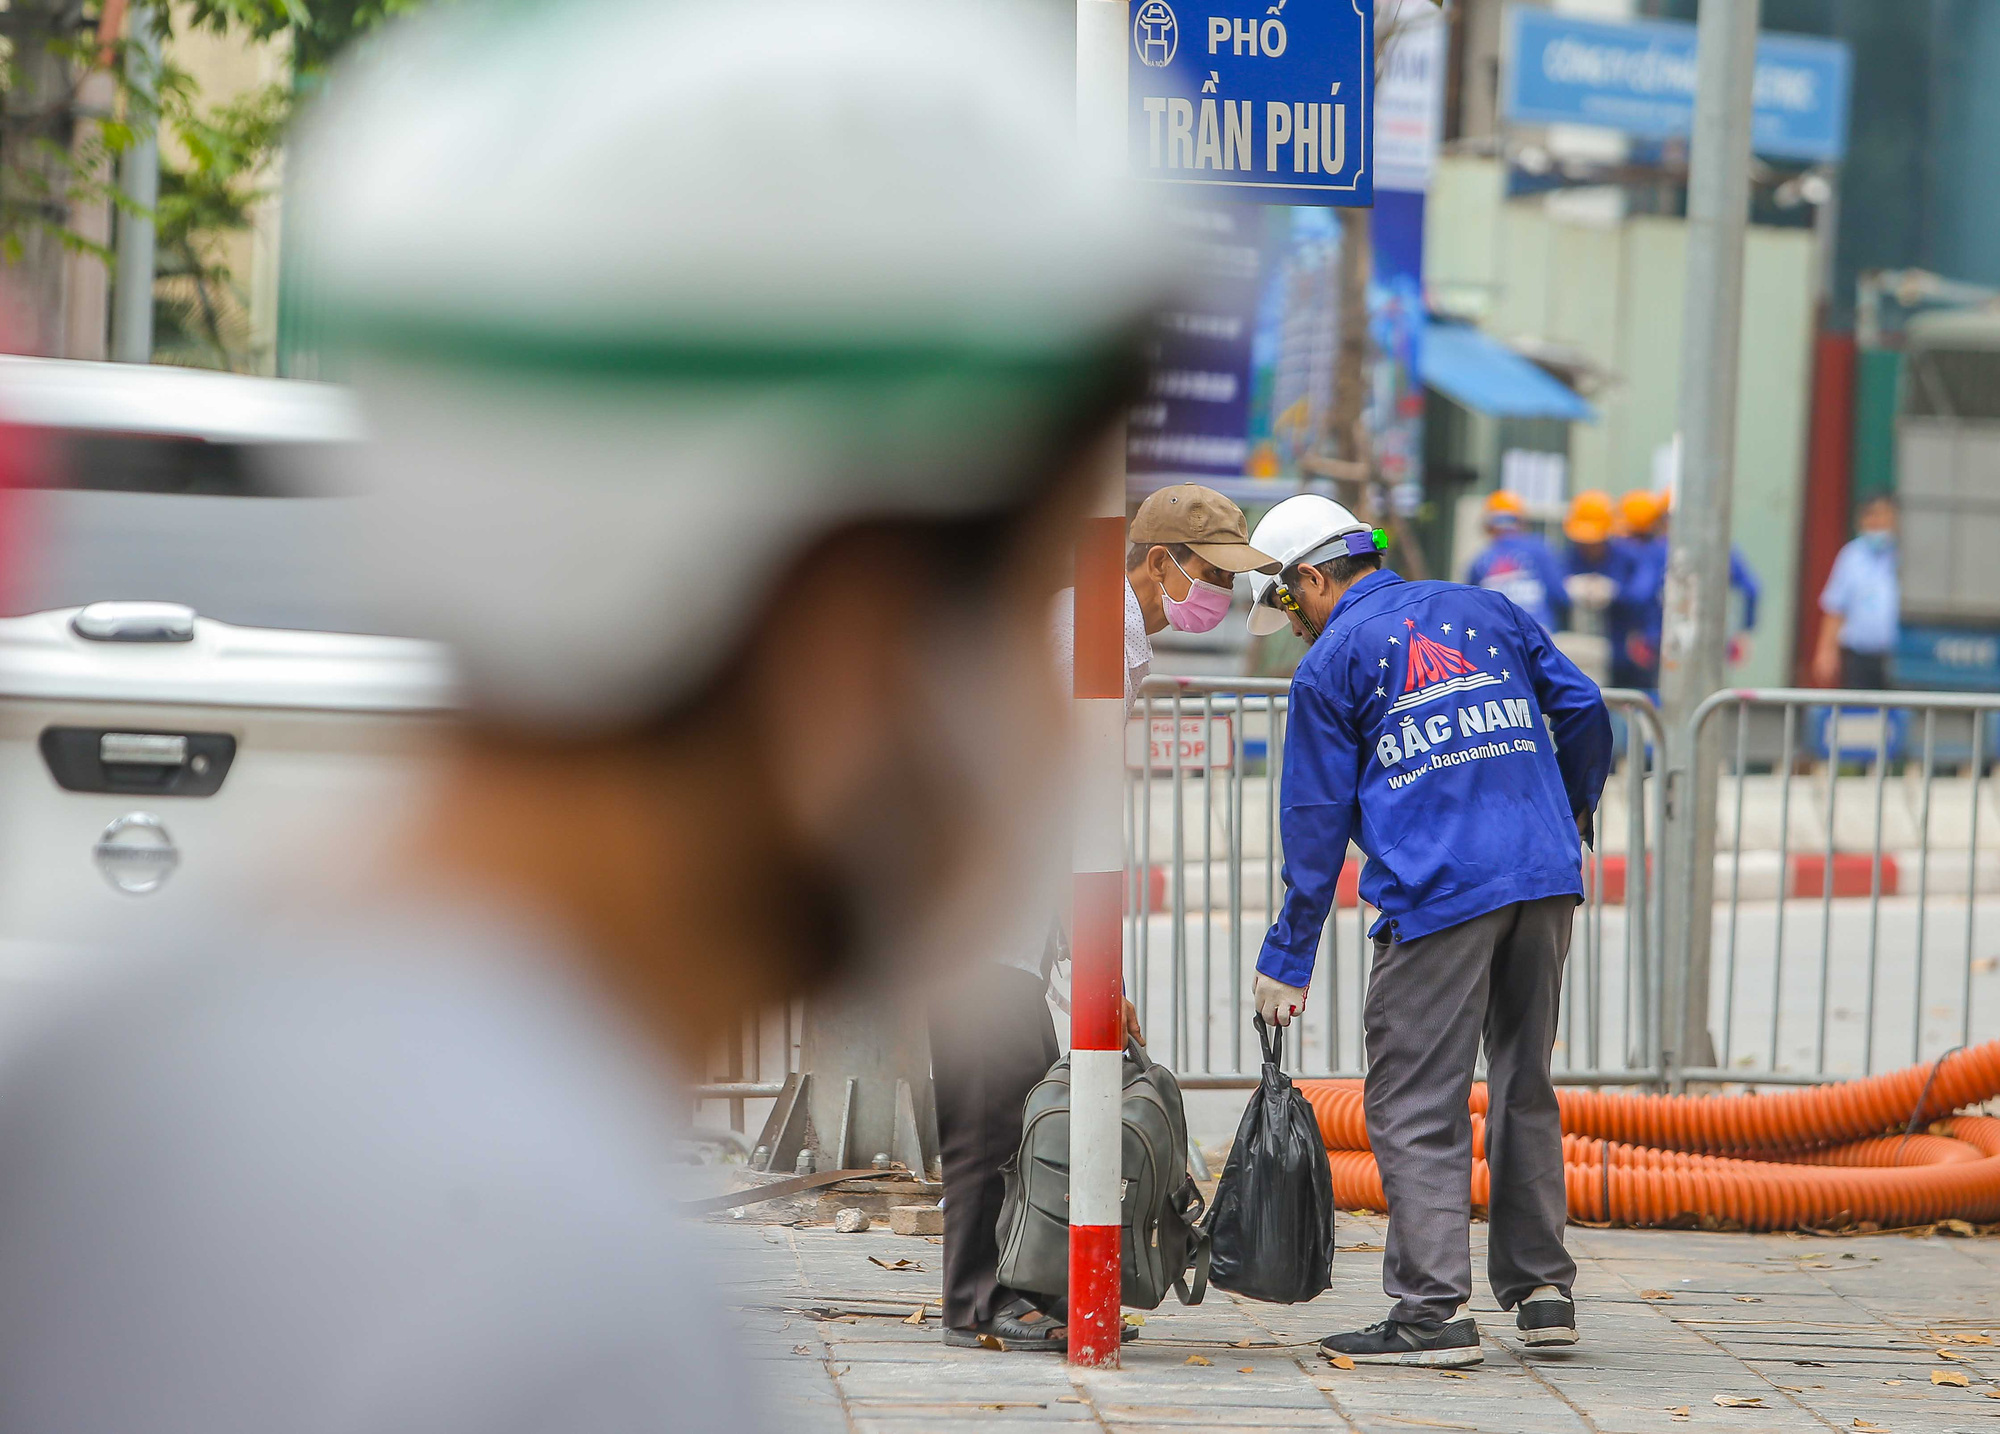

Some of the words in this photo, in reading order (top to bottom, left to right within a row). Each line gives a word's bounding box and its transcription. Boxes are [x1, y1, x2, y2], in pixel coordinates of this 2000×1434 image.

[1208, 0, 1287, 58] PHỐ
[1144, 71, 1252, 171] TRẦN
[1267, 82, 1345, 175] PHÚ
[1150, 741, 1206, 758] STOP
[1376, 714, 1452, 768] BẮC
[1457, 698, 1533, 738] NAM
[1388, 738, 1537, 790] www.bacnamhn.com
